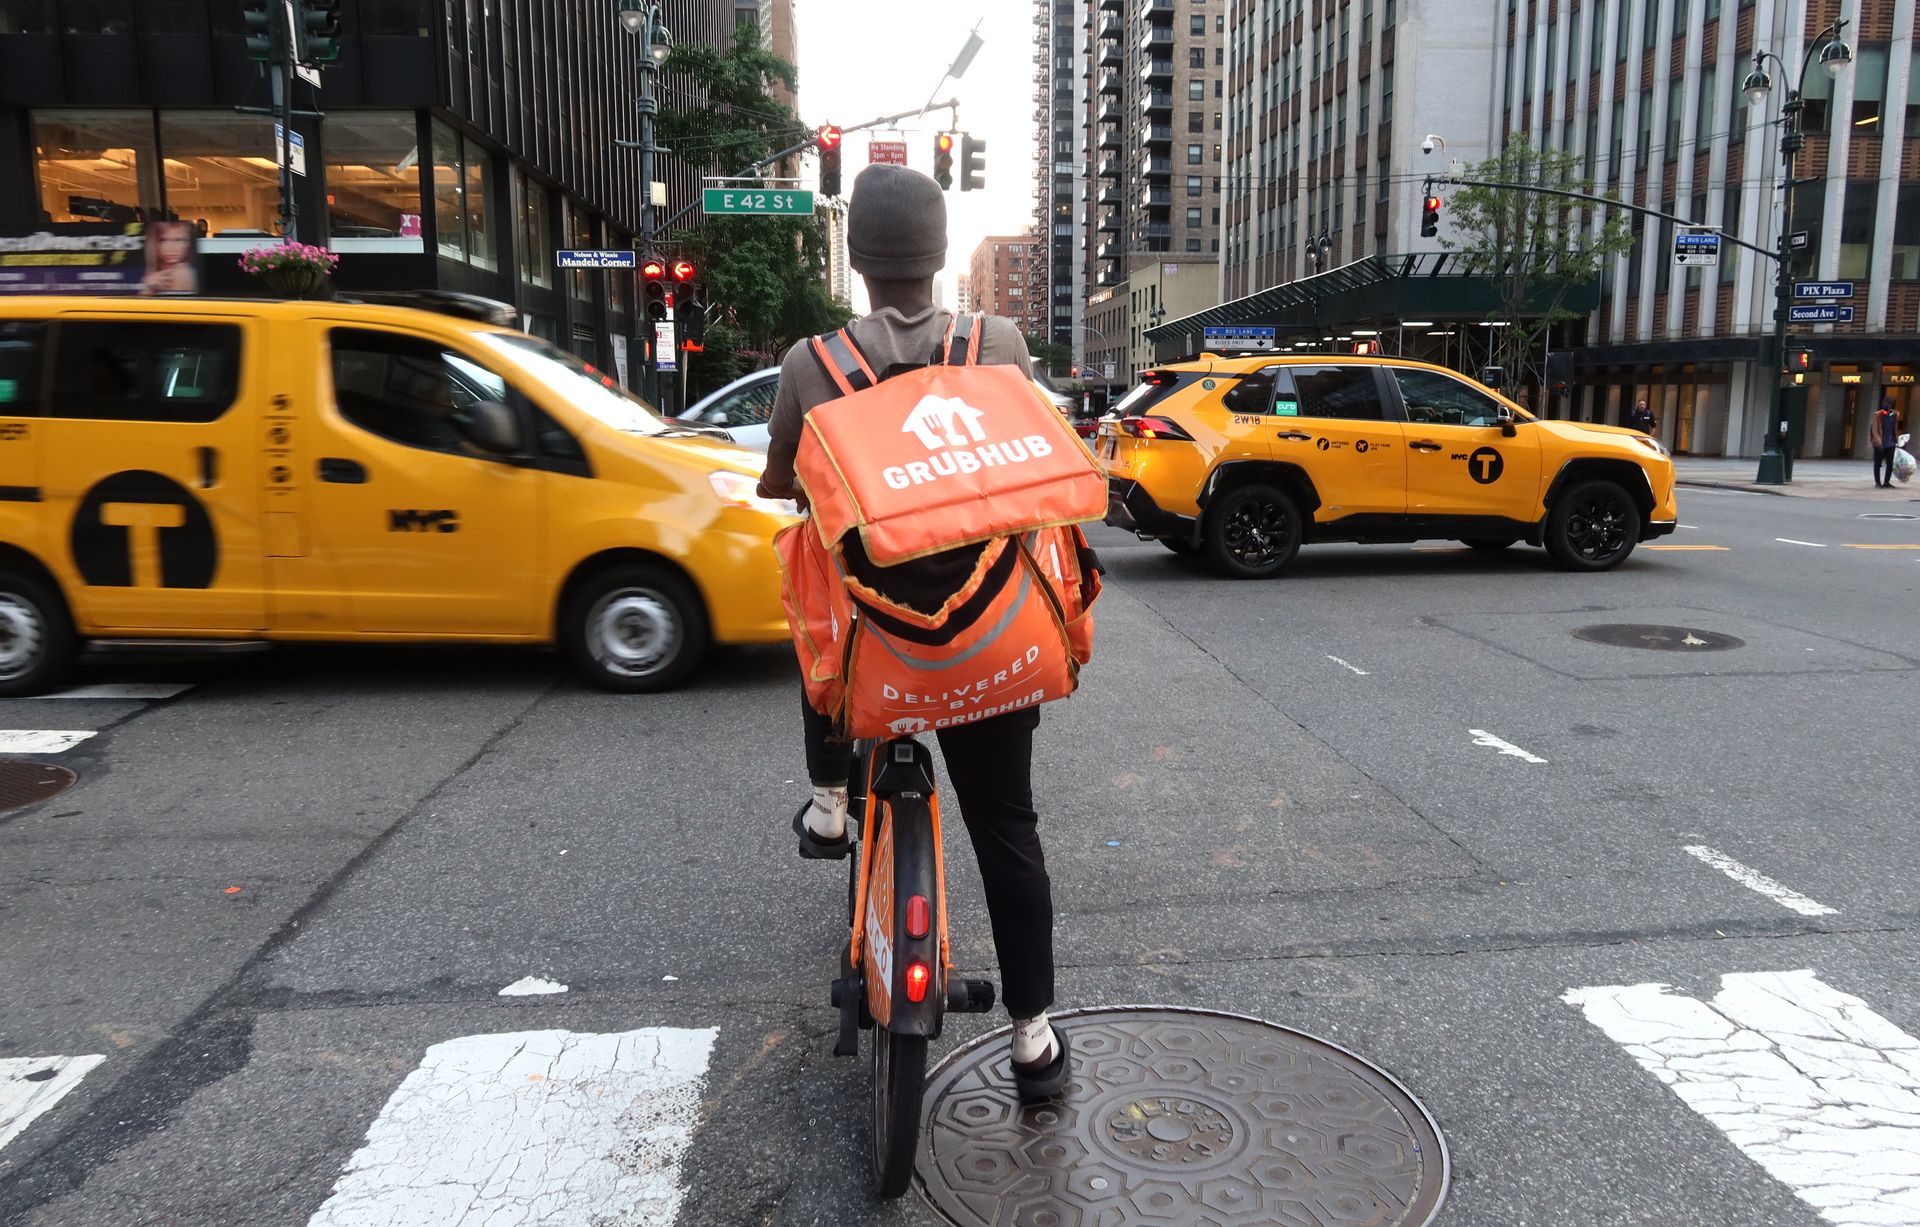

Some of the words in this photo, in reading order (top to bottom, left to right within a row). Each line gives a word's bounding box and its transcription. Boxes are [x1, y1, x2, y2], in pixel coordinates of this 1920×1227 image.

[880, 143, 904, 153] Standing
[723, 194, 735, 209] E
[740, 194, 766, 209] 42
[772, 194, 793, 209] St
[562, 258, 599, 267] Mandela
[600, 258, 631, 267] Corner
[1802, 286, 1820, 295] PIX
[1822, 286, 1845, 295] Plaza
[1792, 309, 1819, 319] Second
[1819, 309, 1834, 318] Ave
[1890, 375, 1915, 383] PLAZA
[1234, 415, 1261, 425] 2W18
[882, 435, 1053, 490] GRUBHUB
[1451, 453, 1468, 461] NYC
[1477, 454, 1496, 480] T
[387, 509, 460, 533] NYC
[101, 502, 187, 588] T
[882, 645, 1040, 704] DELIVERED
[935, 688, 1045, 728] GRUBHUB
[949, 694, 986, 710] BY
